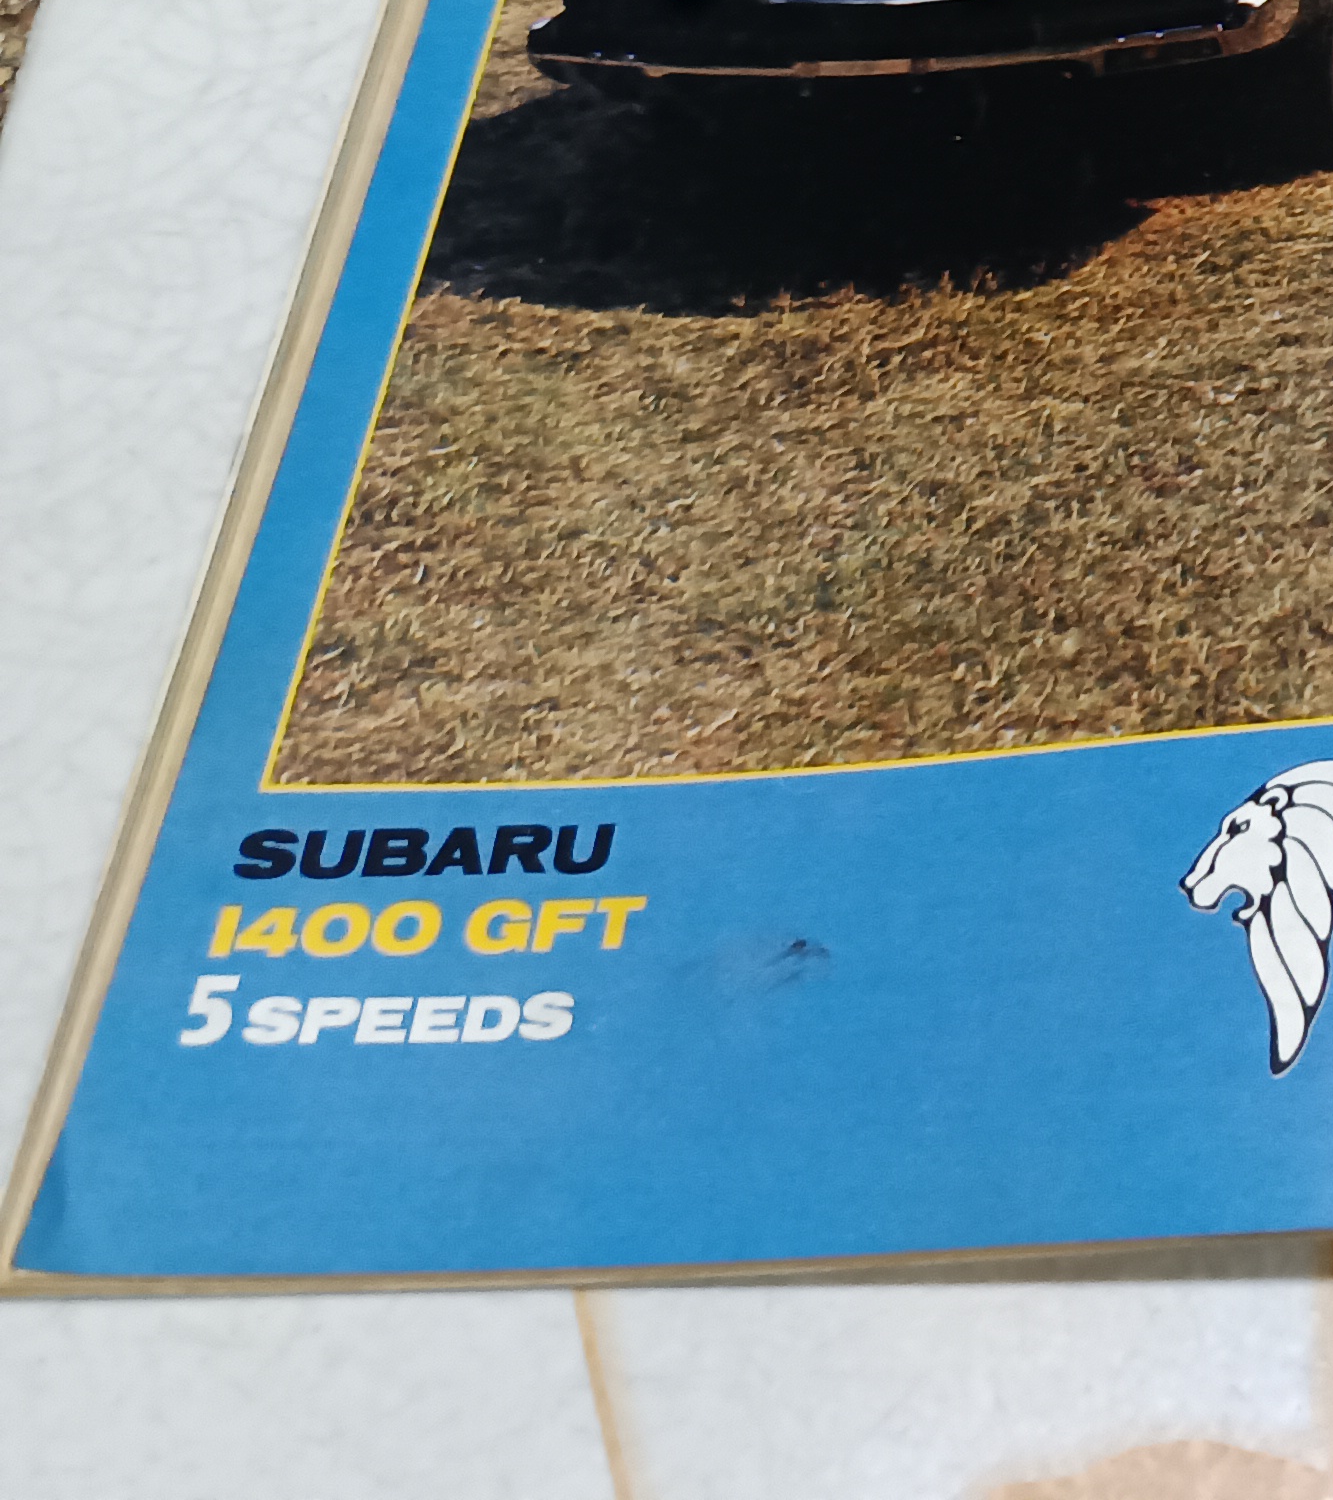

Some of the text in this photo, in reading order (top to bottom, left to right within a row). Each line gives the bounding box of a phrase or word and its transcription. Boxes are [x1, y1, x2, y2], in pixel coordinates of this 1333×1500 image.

[233, 823, 617, 880] SUBARU
[206, 895, 649, 959] 1400 GFT
[178, 974, 576, 1047] 5 SPEEDS
